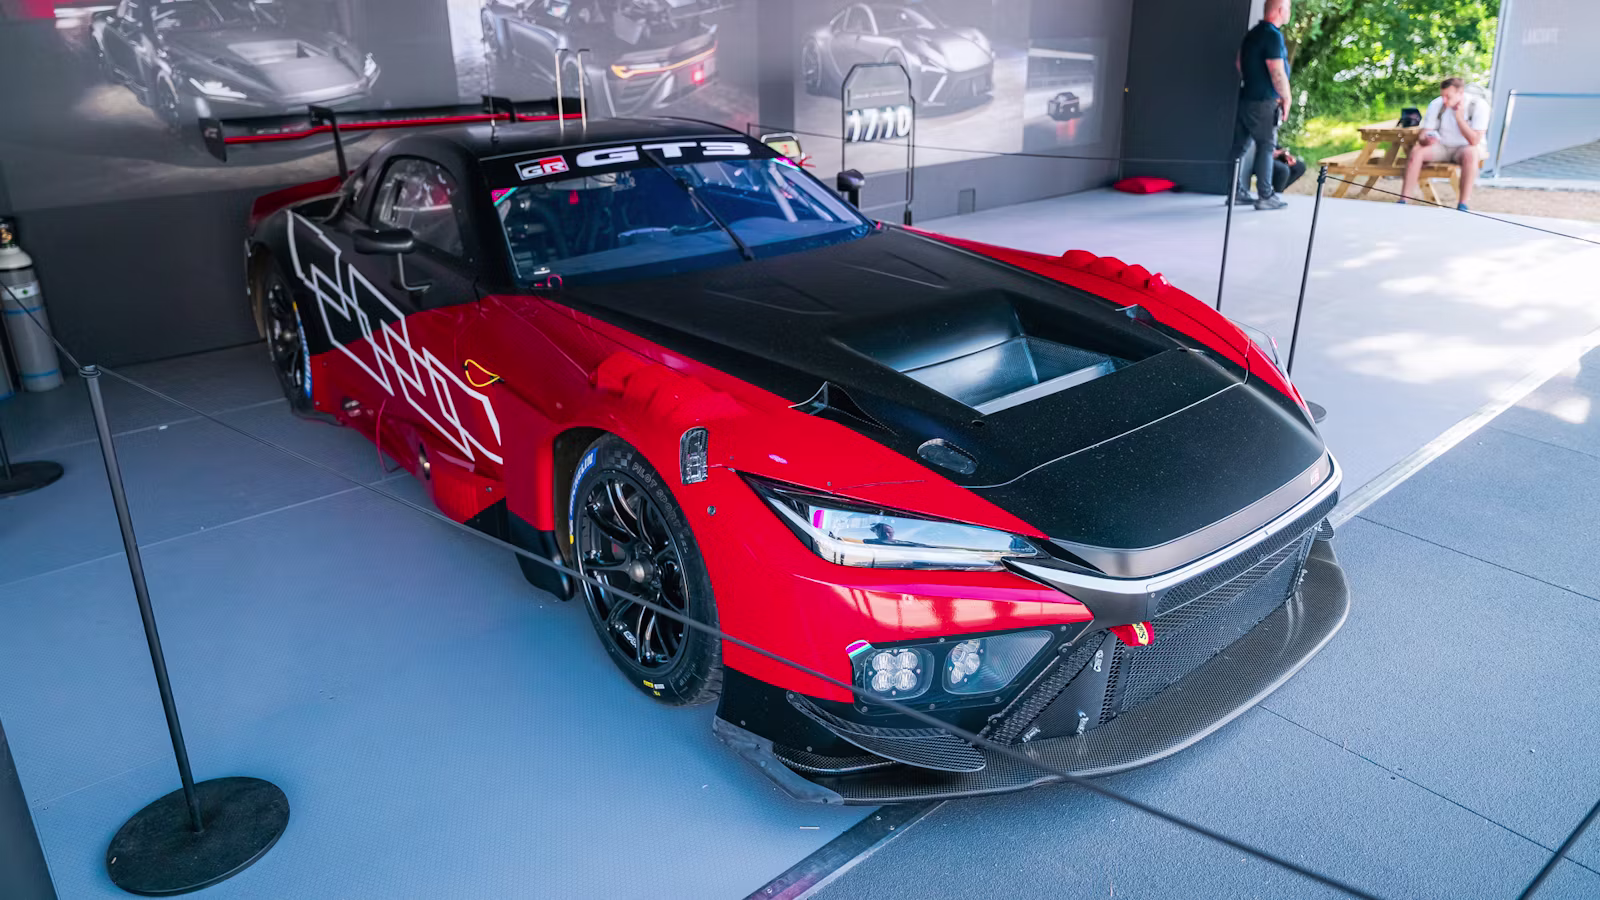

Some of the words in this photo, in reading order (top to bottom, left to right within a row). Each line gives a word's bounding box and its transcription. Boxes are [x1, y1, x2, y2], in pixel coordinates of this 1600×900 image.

[576, 141, 751, 168] GT3
[632, 461, 658, 488] PILOT
[656, 488, 682, 528] SPORT
